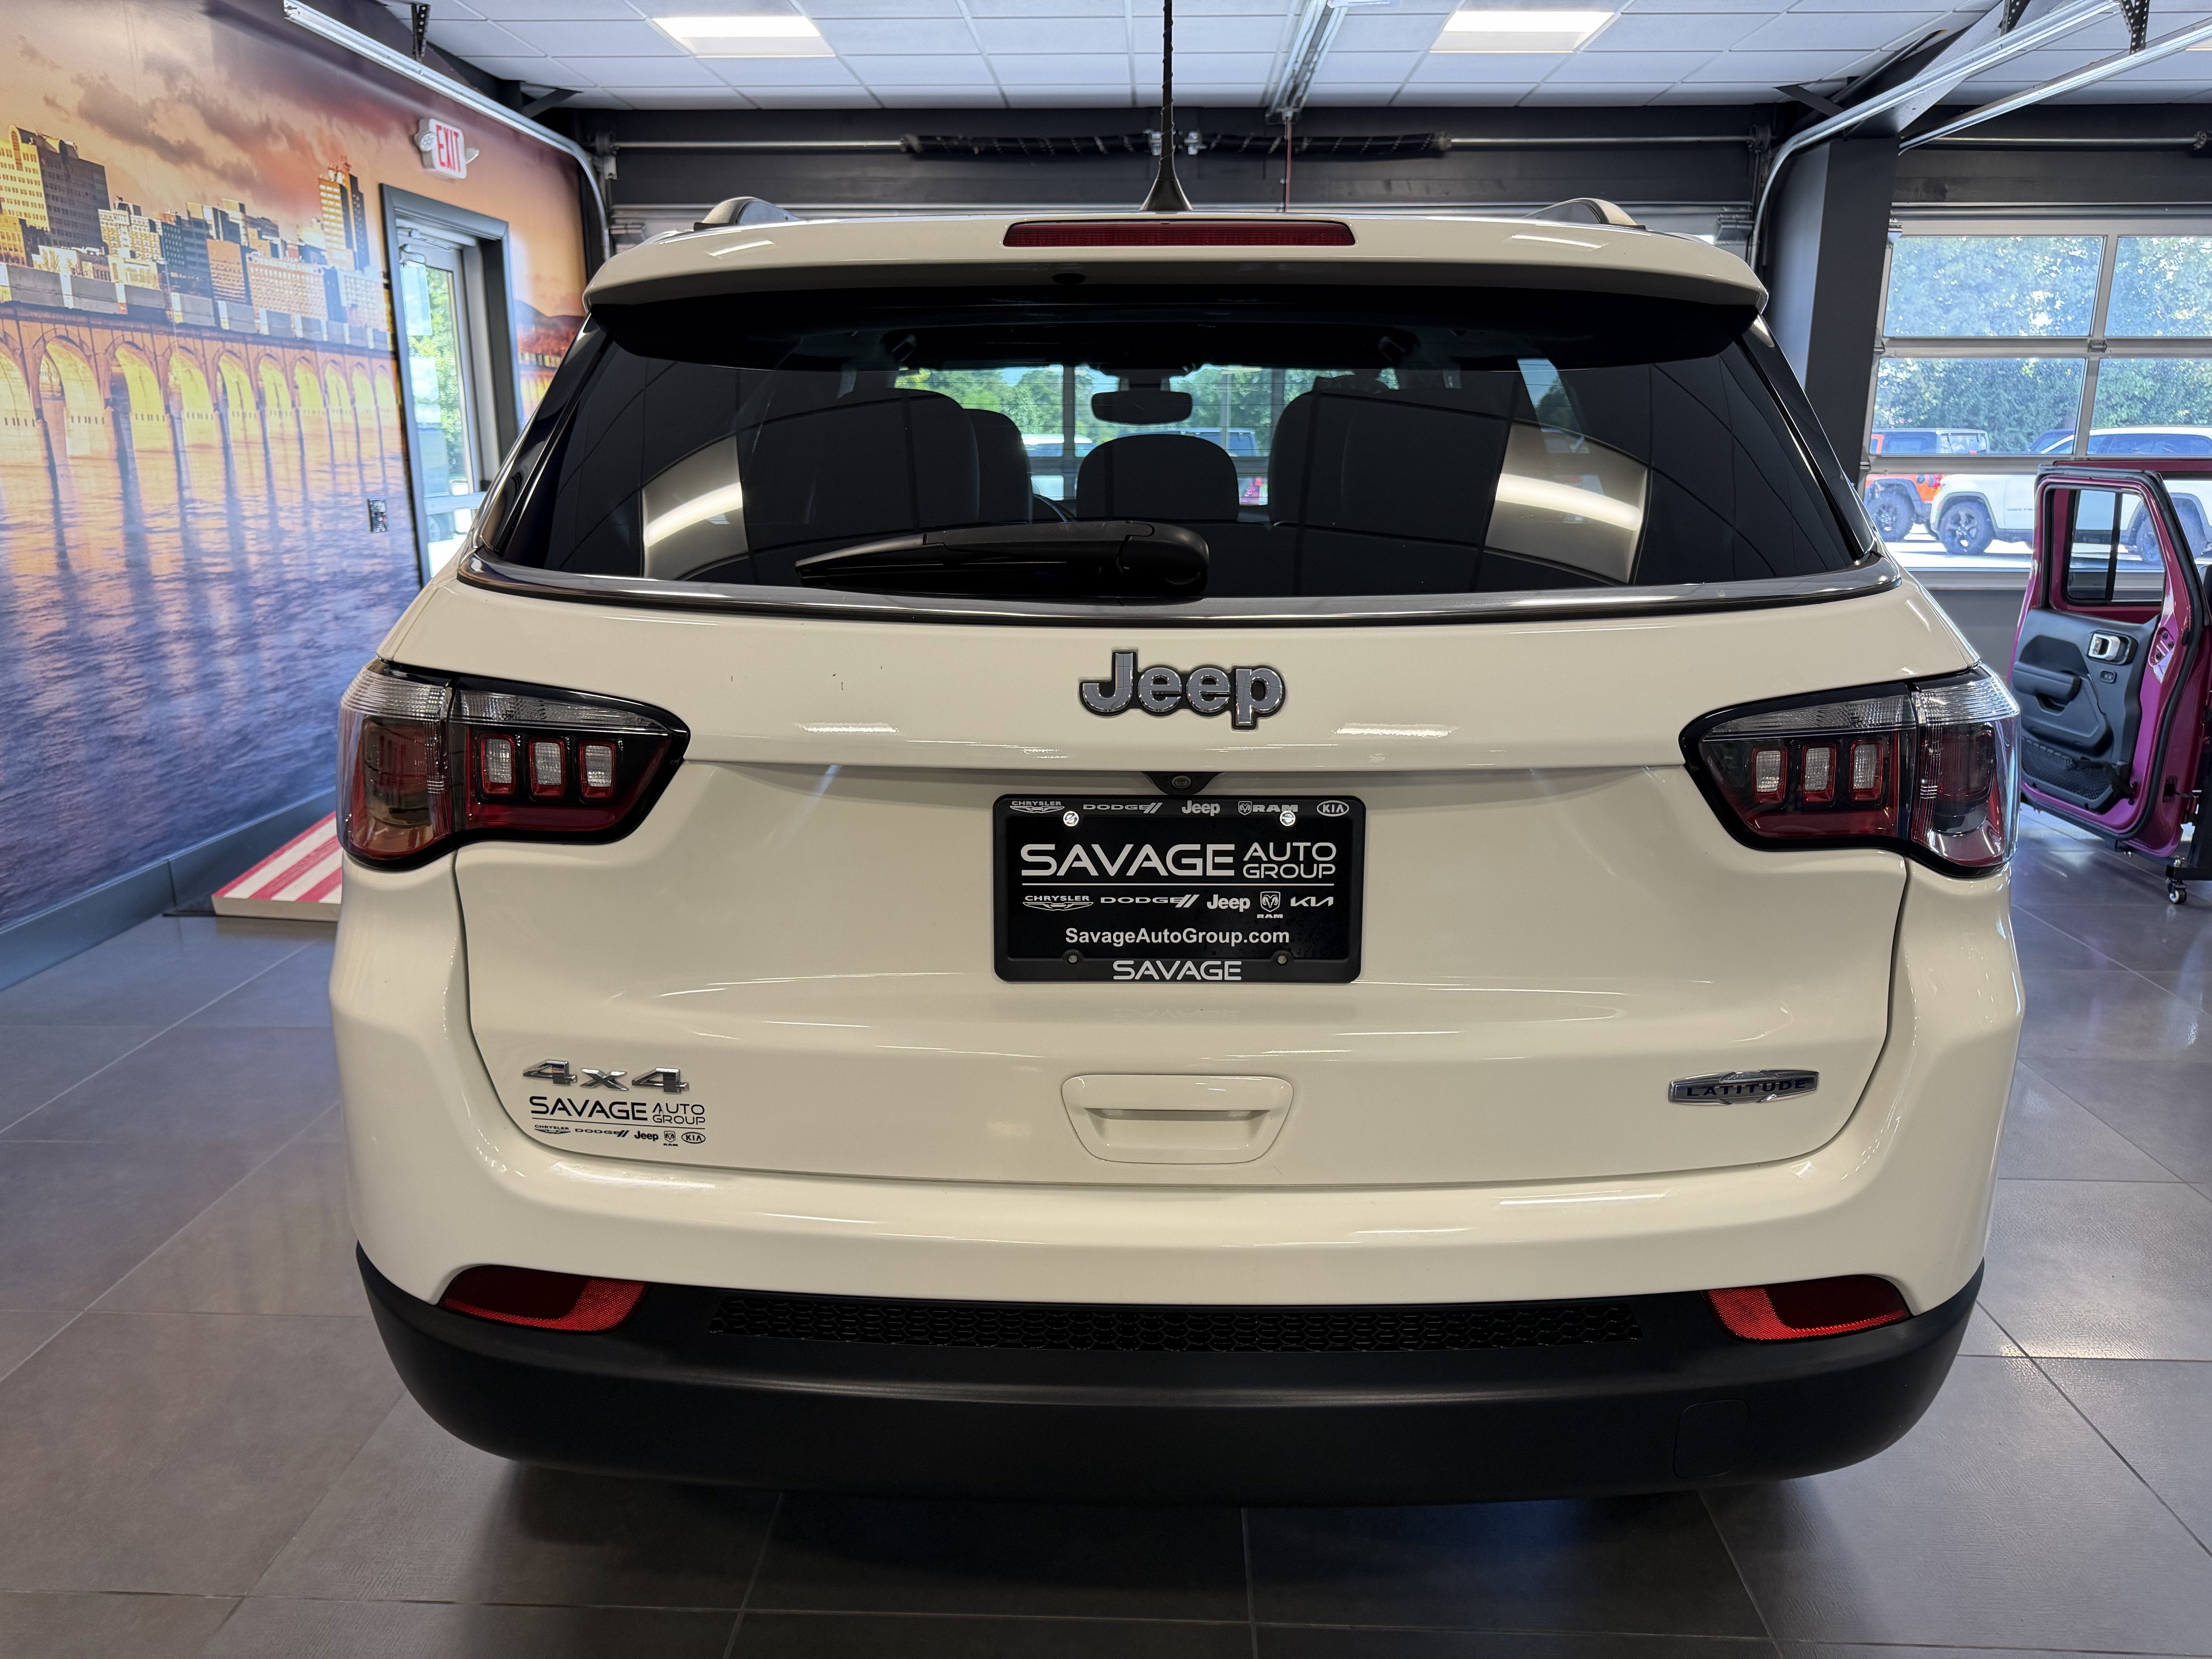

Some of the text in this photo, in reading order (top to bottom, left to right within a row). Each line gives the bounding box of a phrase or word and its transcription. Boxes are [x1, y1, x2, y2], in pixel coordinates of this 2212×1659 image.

[436, 124, 461, 173] EXIT
[1080, 652, 1284, 728] Jeep
[1182, 800, 1221, 816] Jeep
[1252, 804, 1298, 812] RAM
[1322, 804, 1344, 813] KIA
[1020, 842, 1337, 877] SAVAGE AUTO
[1242, 863, 1336, 879] GROUP
[1100, 896, 1185, 904] DODGE
[1206, 894, 1251, 912] Jeep
[1290, 896, 1334, 907] KIA
[1065, 927, 1290, 947] SavageAutoGroup.com
[1113, 960, 1242, 981] SAVAGE
[523, 1059, 690, 1095] 4x4
[1686, 1078, 1806, 1096] LATITUDE
[529, 1096, 705, 1121] SAVAGE AUTO
[652, 1115, 706, 1125] GROUP
[634, 1130, 659, 1142] Jeep
